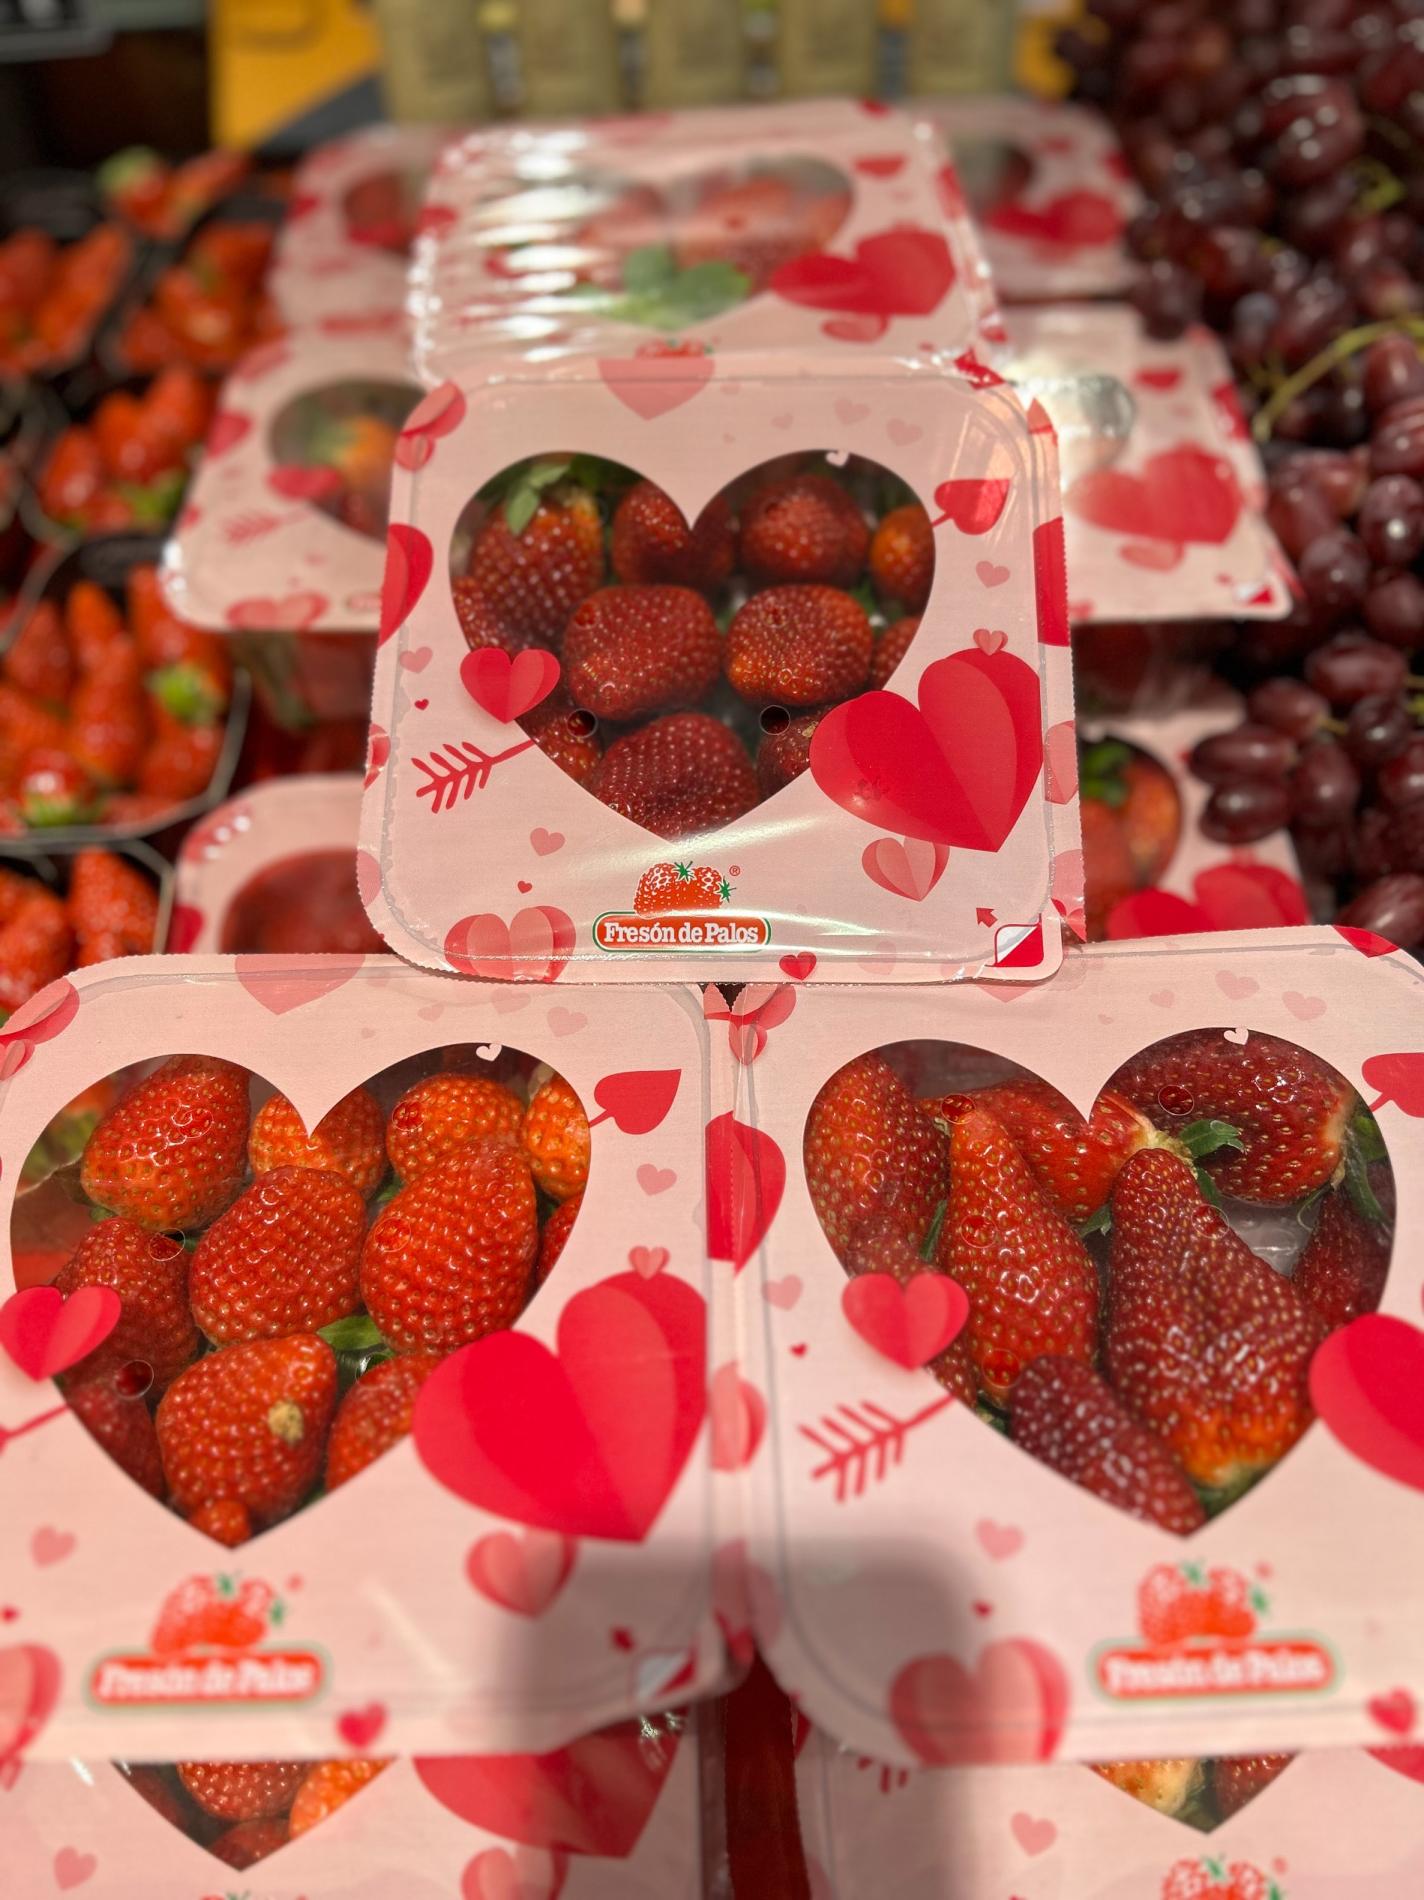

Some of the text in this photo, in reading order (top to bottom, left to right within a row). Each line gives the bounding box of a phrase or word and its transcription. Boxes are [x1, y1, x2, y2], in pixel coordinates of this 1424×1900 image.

[603, 921, 759, 944] Fresón de Palos
